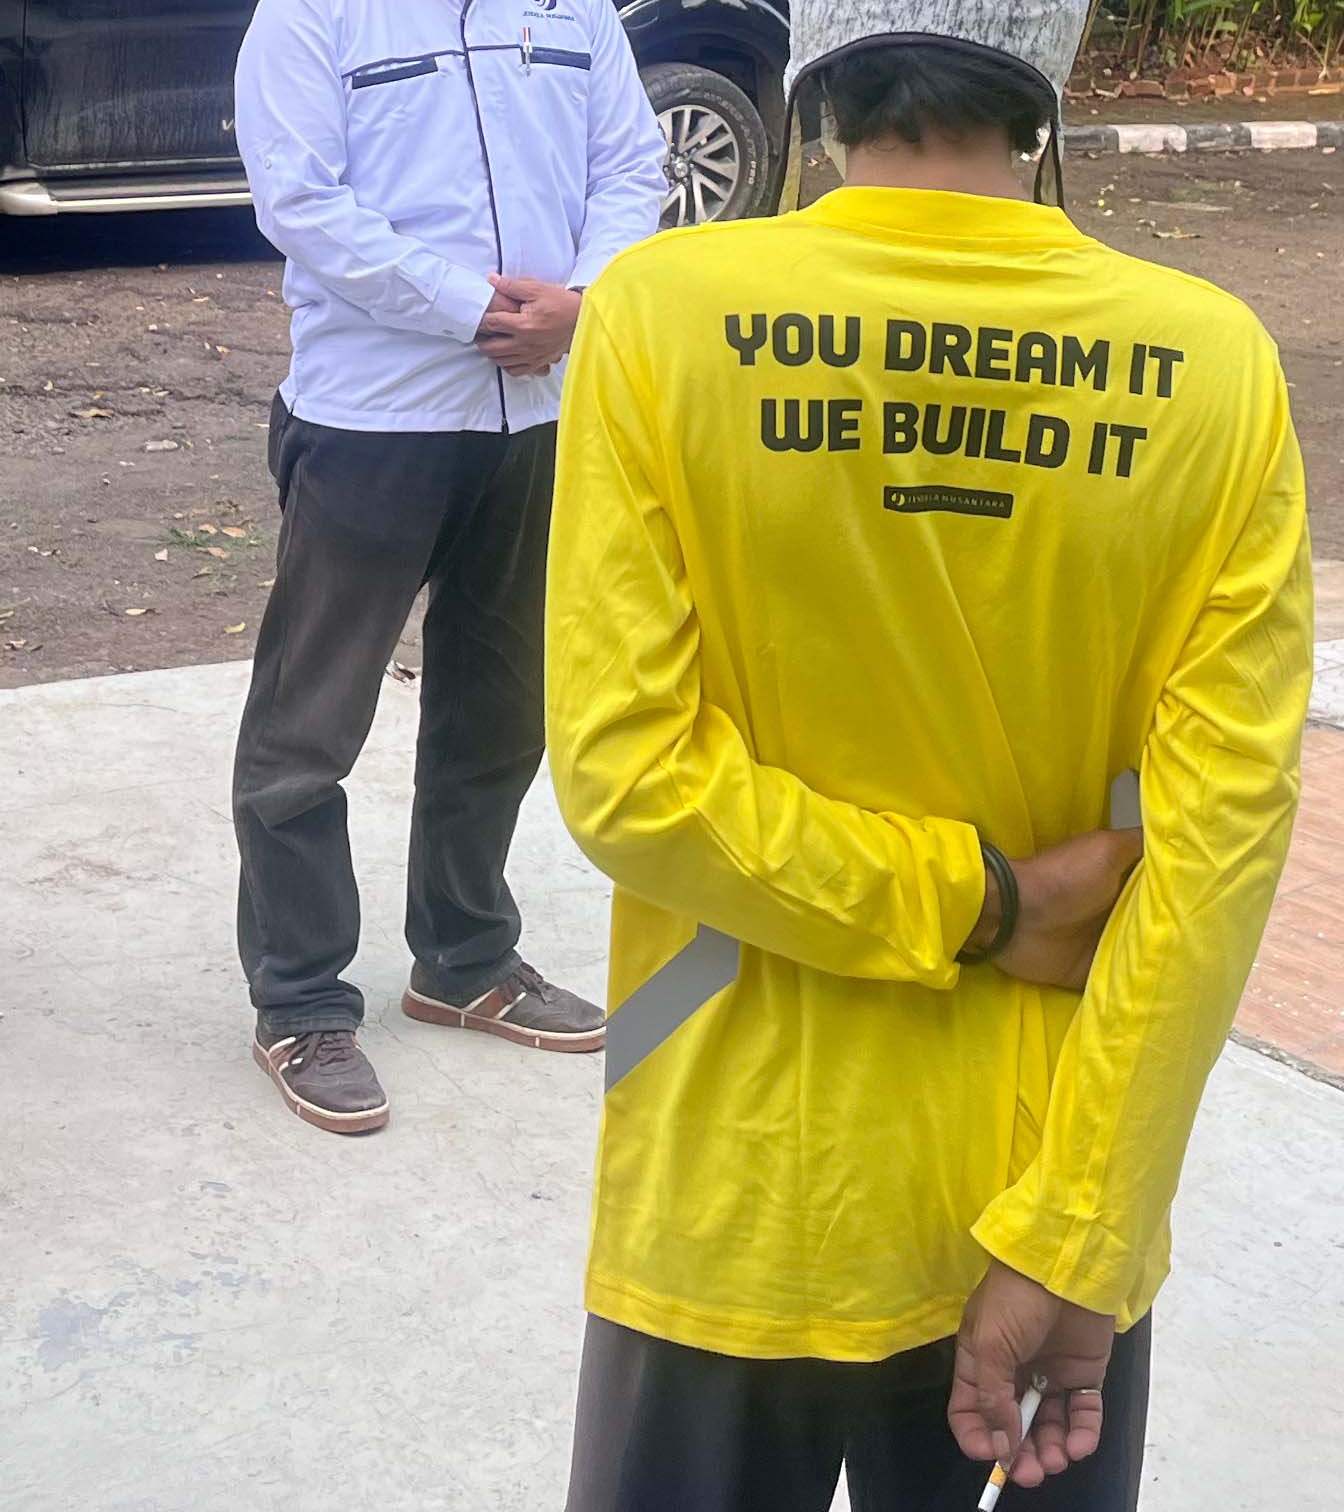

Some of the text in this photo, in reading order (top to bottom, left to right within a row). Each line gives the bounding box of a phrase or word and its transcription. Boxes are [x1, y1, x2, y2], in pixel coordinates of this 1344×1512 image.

[724, 313, 1185, 399] YOU DREAM IT
[760, 398, 1148, 478] WE BUILD IT
